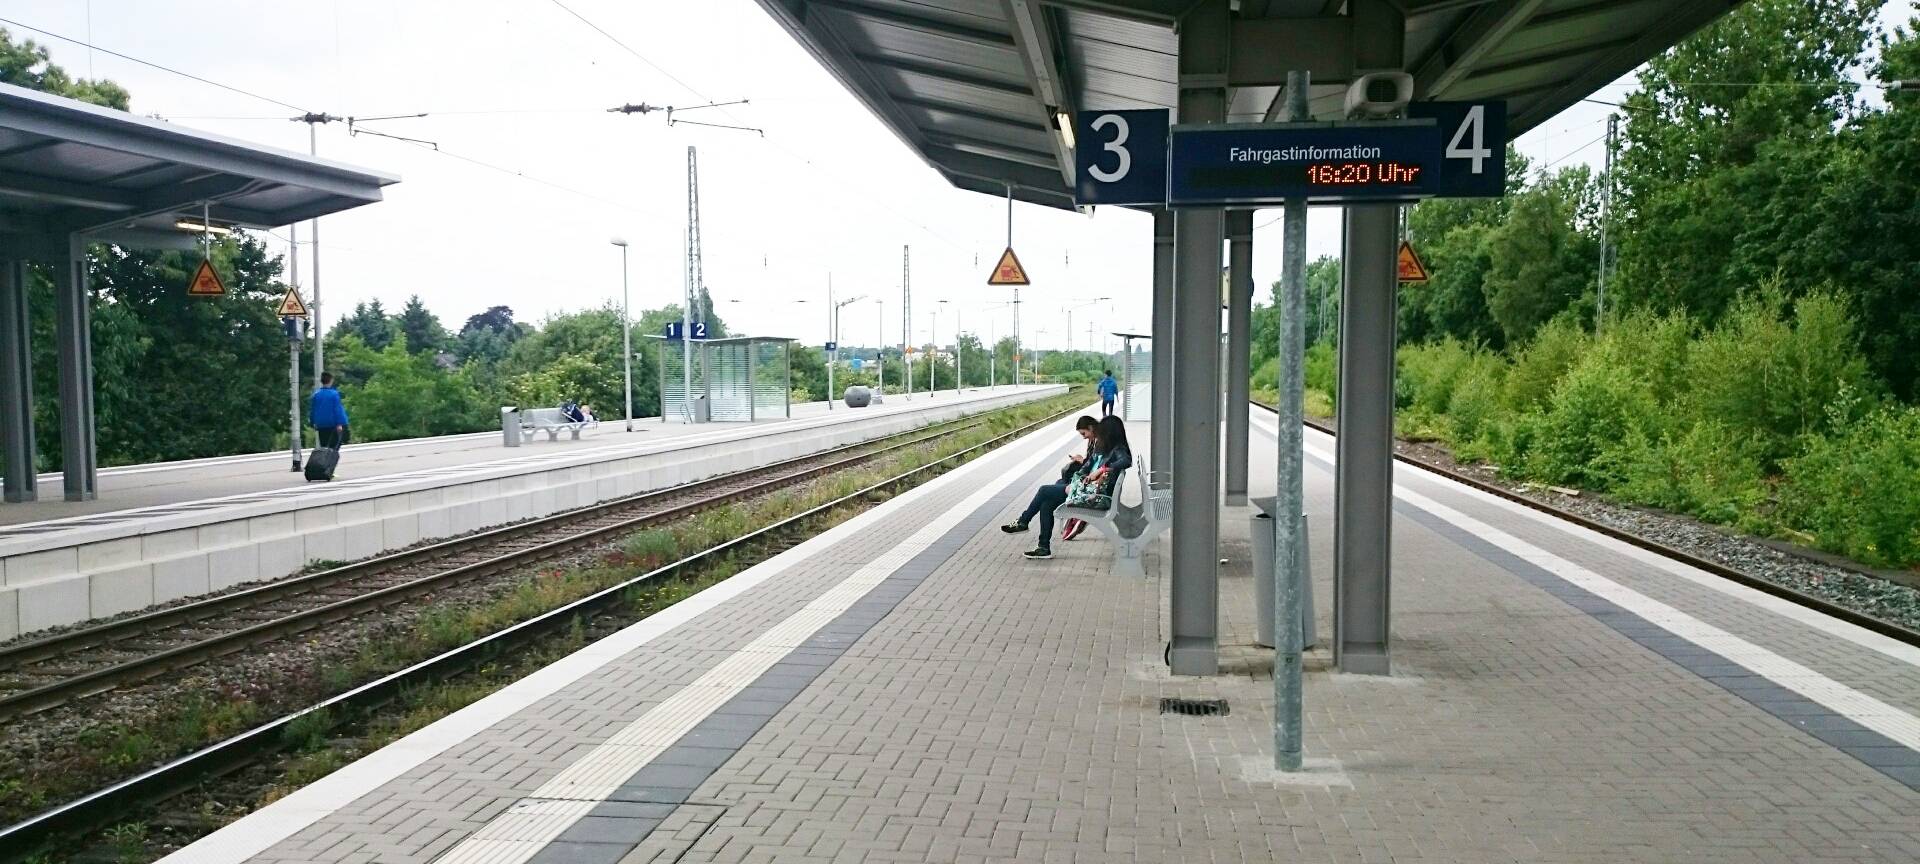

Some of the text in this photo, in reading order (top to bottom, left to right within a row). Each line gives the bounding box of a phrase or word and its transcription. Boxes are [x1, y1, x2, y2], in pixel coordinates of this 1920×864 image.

[1087, 114, 1131, 183] 3
[1445, 105, 1492, 174] 4
[1229, 144, 1381, 164] Fahrgastinformation
[1307, 163, 1420, 184] 16:20 Uhr
[668, 323, 674, 336] 1
[696, 323, 705, 336] 2
